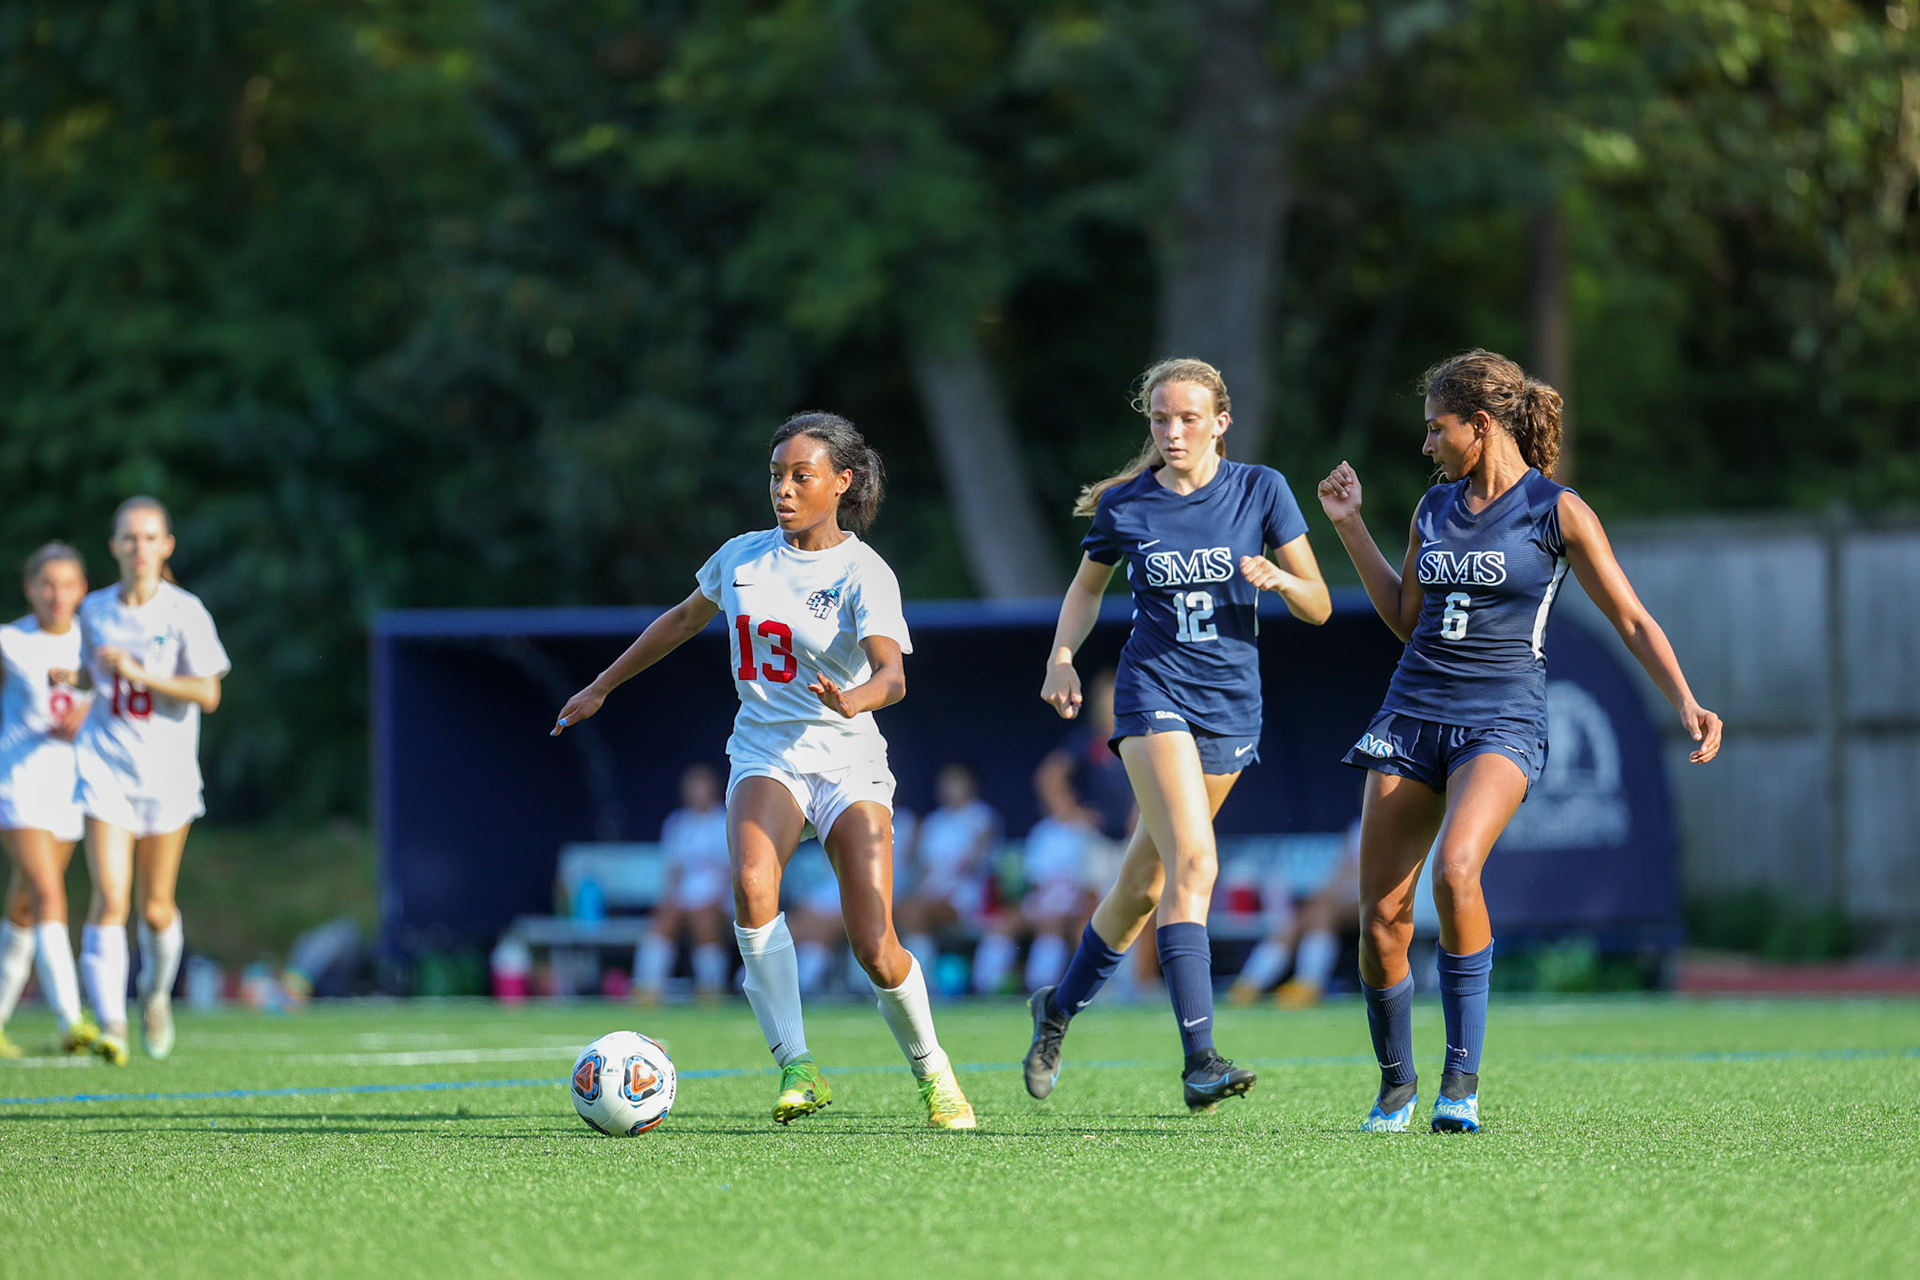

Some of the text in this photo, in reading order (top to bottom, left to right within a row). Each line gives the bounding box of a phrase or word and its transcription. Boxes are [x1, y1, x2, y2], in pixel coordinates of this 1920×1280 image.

[1145, 547, 1234, 587] SMS
[1418, 550, 1507, 586] SMS
[1173, 591, 1218, 642] 12
[1440, 592, 1471, 640] 6
[736, 614, 797, 684] 13
